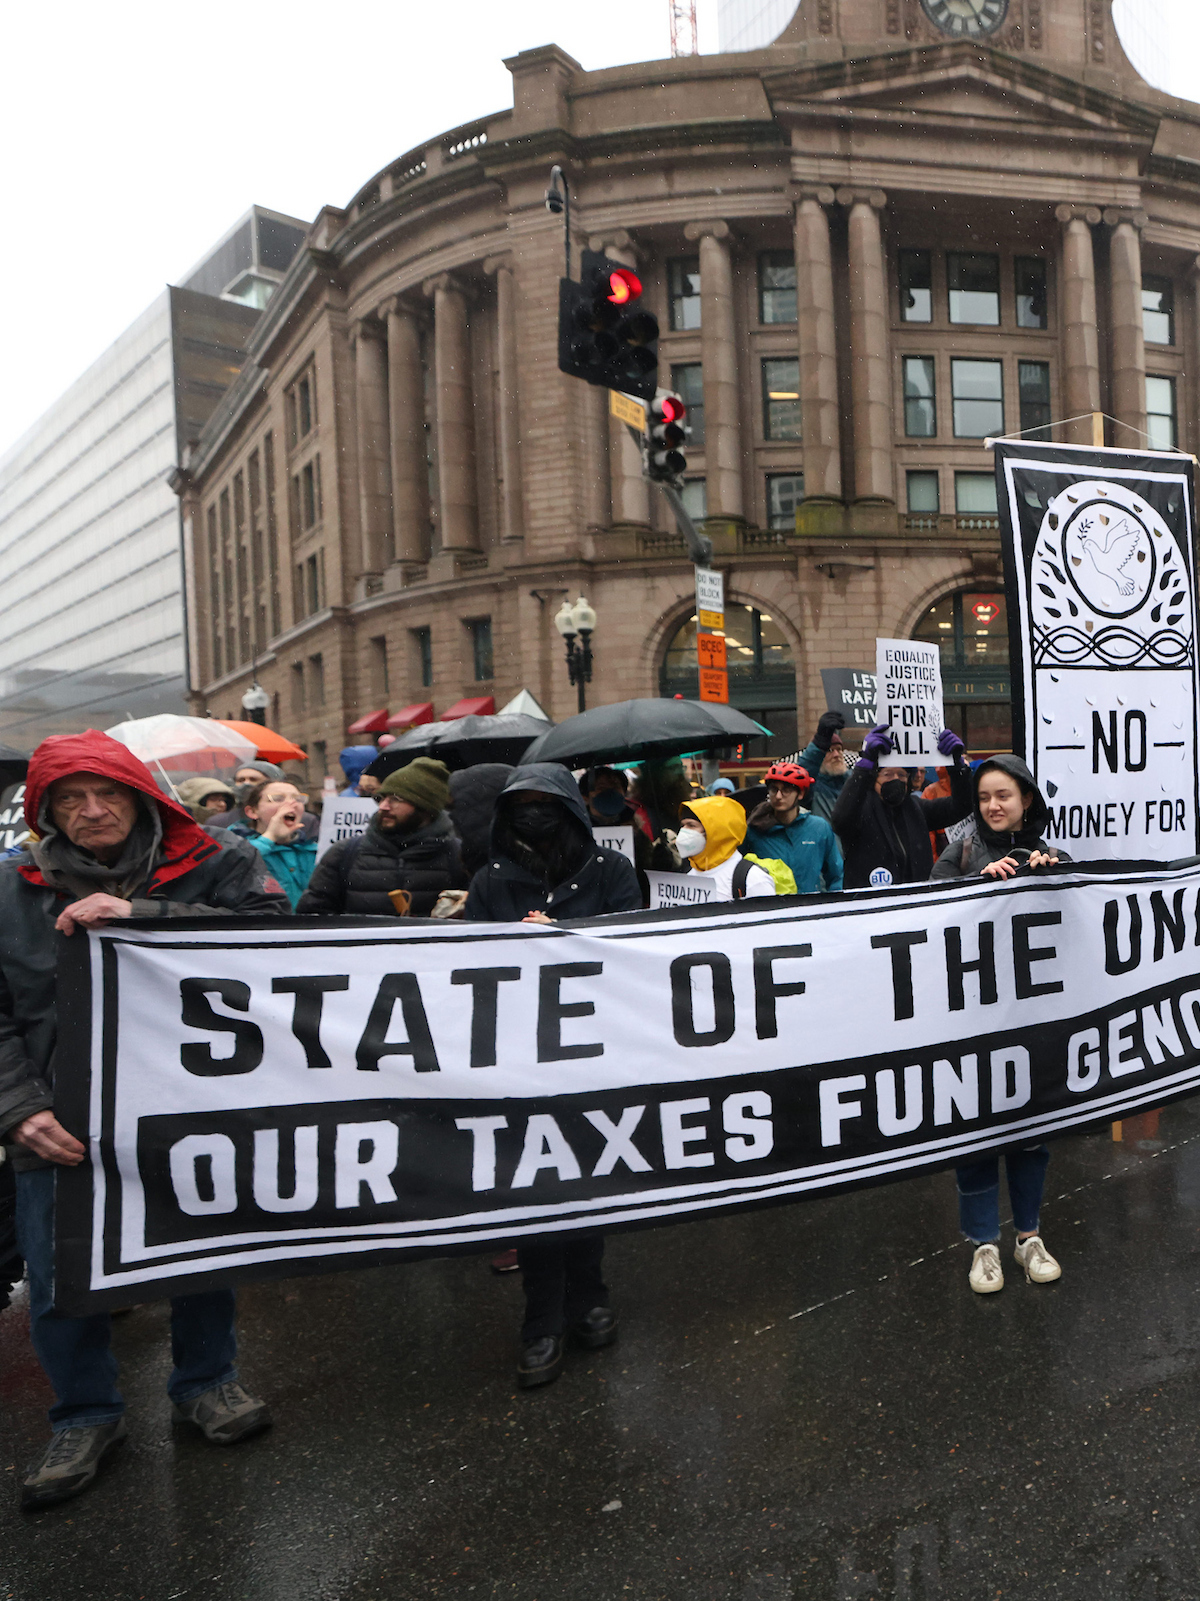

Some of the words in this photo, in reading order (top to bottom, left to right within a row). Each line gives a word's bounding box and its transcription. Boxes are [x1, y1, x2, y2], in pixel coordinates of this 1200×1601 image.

[708, 576, 721, 586] NOT
[700, 587, 720, 599] BLOCK
[701, 639, 722, 653] BCEC
[885, 649, 935, 665] EQUALITY
[885, 665, 935, 681] JUSTICE
[886, 683, 936, 700] SAFETY
[888, 705, 927, 727] FOR
[889, 731, 930, 755] ALL
[1092, 709, 1147, 774] NO
[1046, 801, 1135, 840] MONEY
[1145, 798, 1186, 835] FOR
[871, 871, 890, 884] BTU
[657, 882, 711, 903] EQUALITY
[180, 961, 604, 1077] STATE
[670, 943, 813, 1048] OF
[870, 911, 1065, 1022] THE
[169, 1118, 399, 1216] OUR
[455, 1090, 775, 1193] TAXES
[819, 1044, 1032, 1148] FUND
